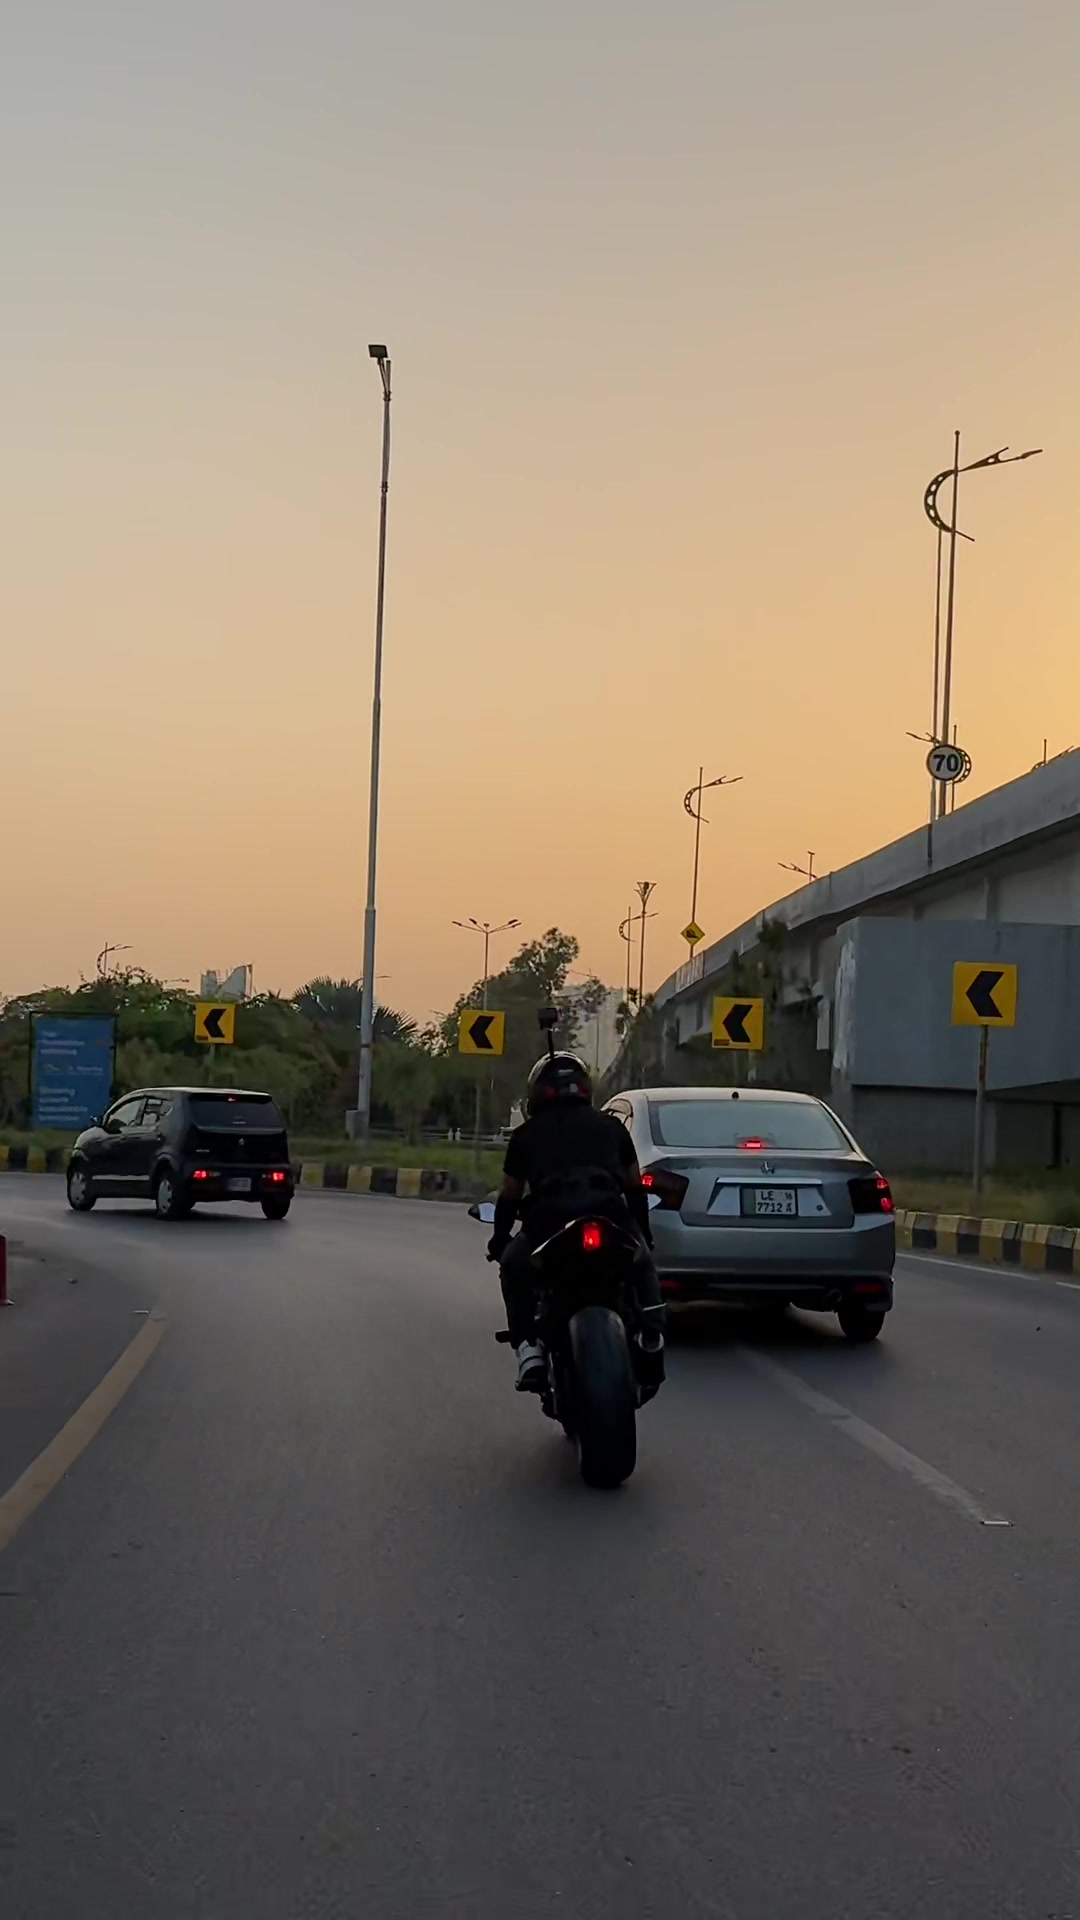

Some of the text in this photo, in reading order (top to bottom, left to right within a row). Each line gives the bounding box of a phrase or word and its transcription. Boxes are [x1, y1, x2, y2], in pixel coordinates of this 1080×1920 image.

[933, 754, 959, 772] 70
[761, 1191, 774, 1201] LE
[757, 1202, 783, 1213] 7712
